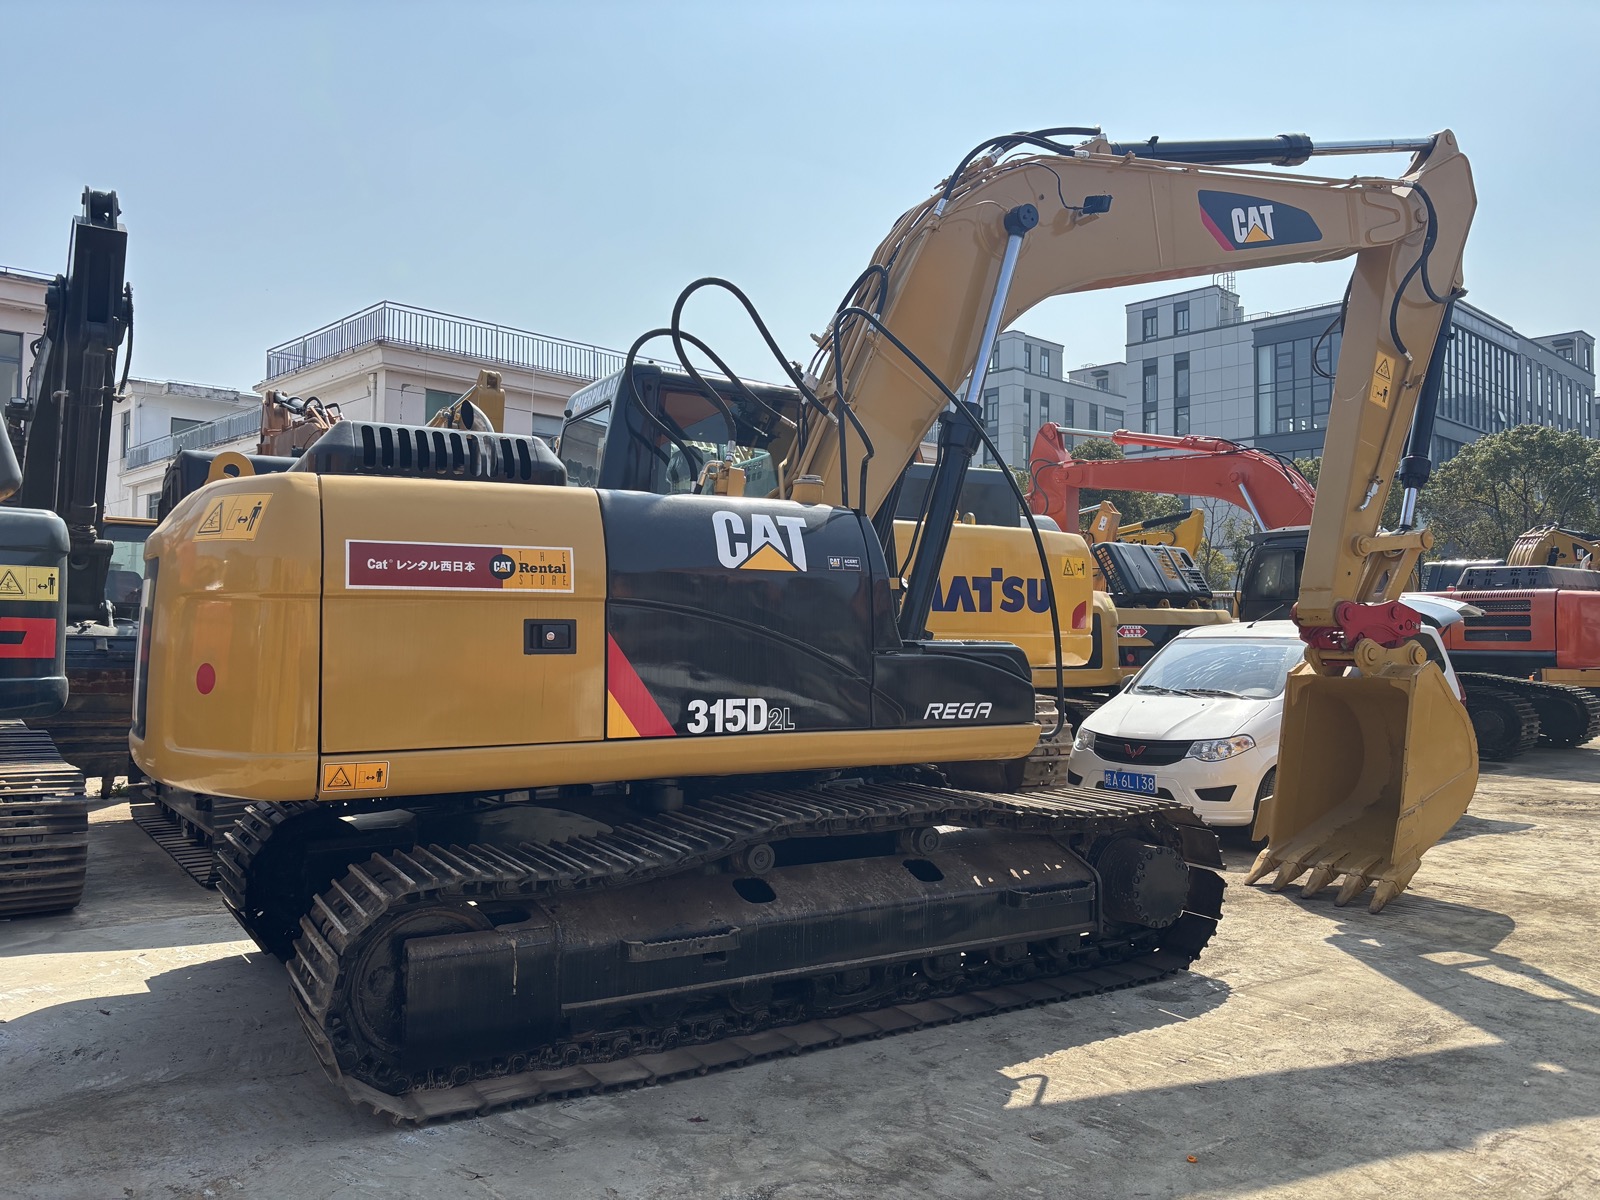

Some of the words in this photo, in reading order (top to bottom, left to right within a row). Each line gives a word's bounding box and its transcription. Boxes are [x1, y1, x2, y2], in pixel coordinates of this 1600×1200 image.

[1231, 205, 1274, 243] CAT
[573, 375, 619, 414] CATERPILLAR
[712, 511, 808, 572] CAT
[519, 551, 566, 563] THE
[396, 560, 475, 572] レンタル西日本
[493, 561, 511, 573] CAT
[519, 563, 566, 574] Rental
[519, 575, 567, 586] STORE
[923, 702, 993, 720] REGA
